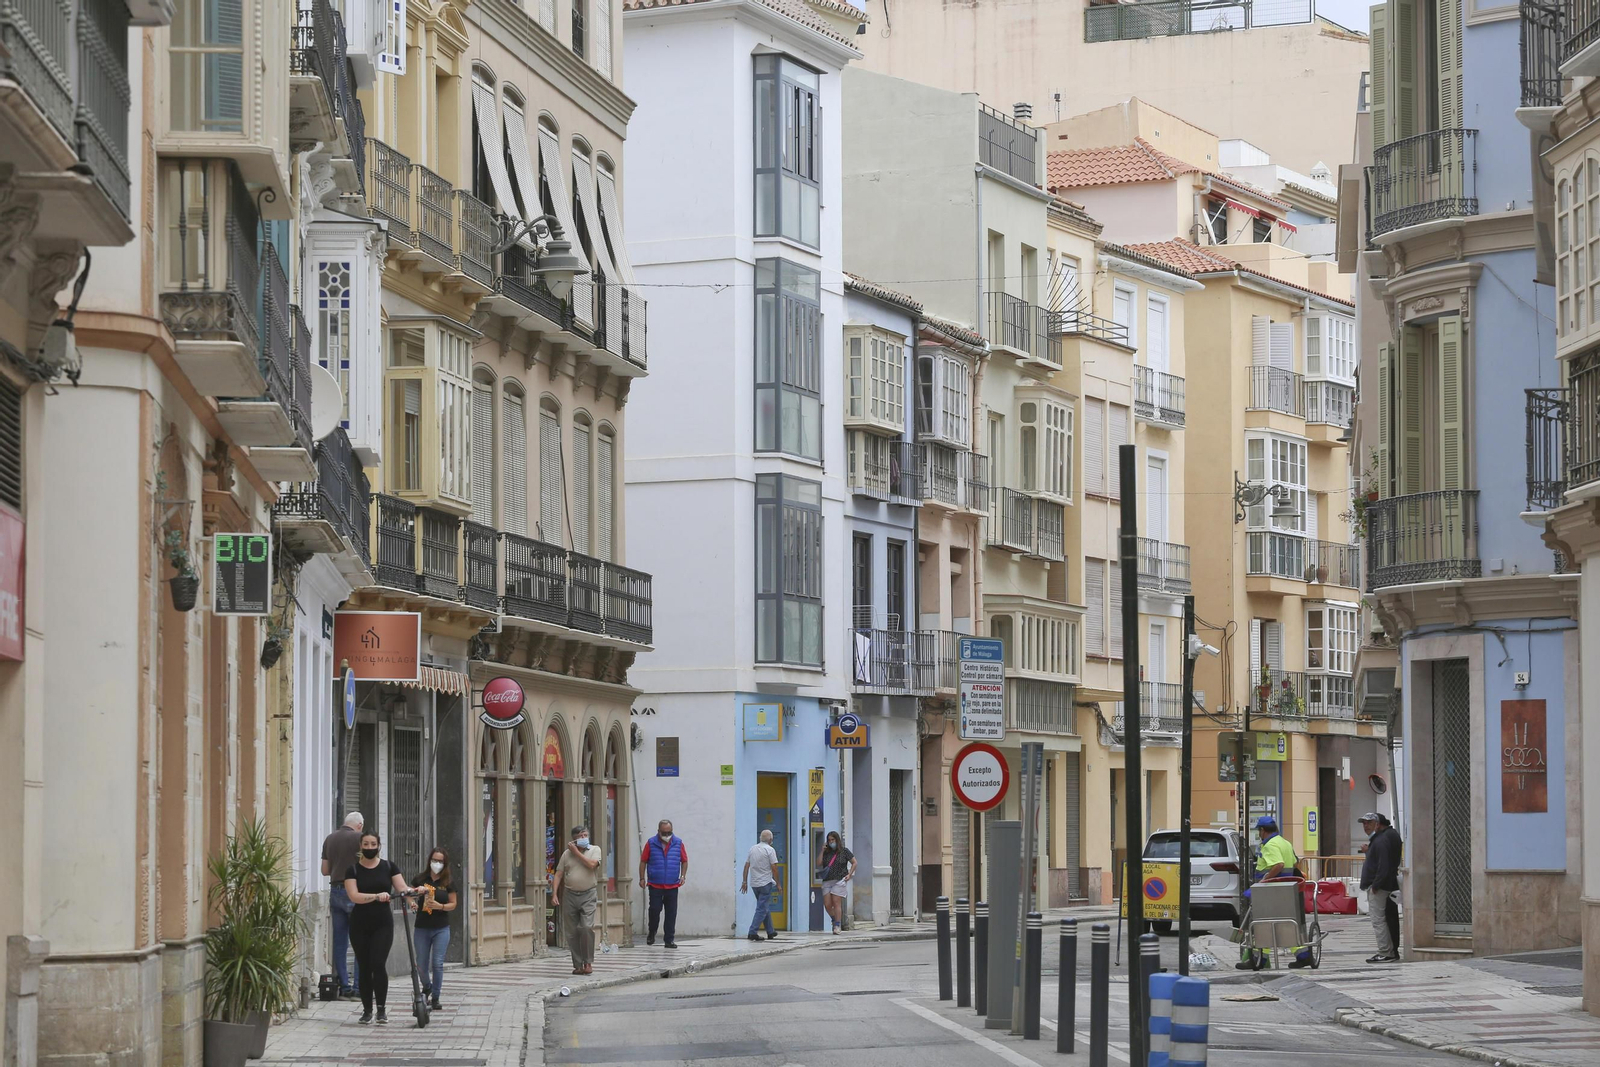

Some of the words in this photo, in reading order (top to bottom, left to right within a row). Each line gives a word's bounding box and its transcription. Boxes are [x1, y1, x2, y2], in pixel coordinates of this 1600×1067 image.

[216, 535, 268, 562] BIO
[979, 664, 999, 672] Histórico
[979, 692, 997, 700] semáforo
[973, 727, 987, 735] ámbar,
[834, 736, 861, 745] ATM
[968, 766, 992, 775] Excepto
[811, 771, 821, 783] ATM
